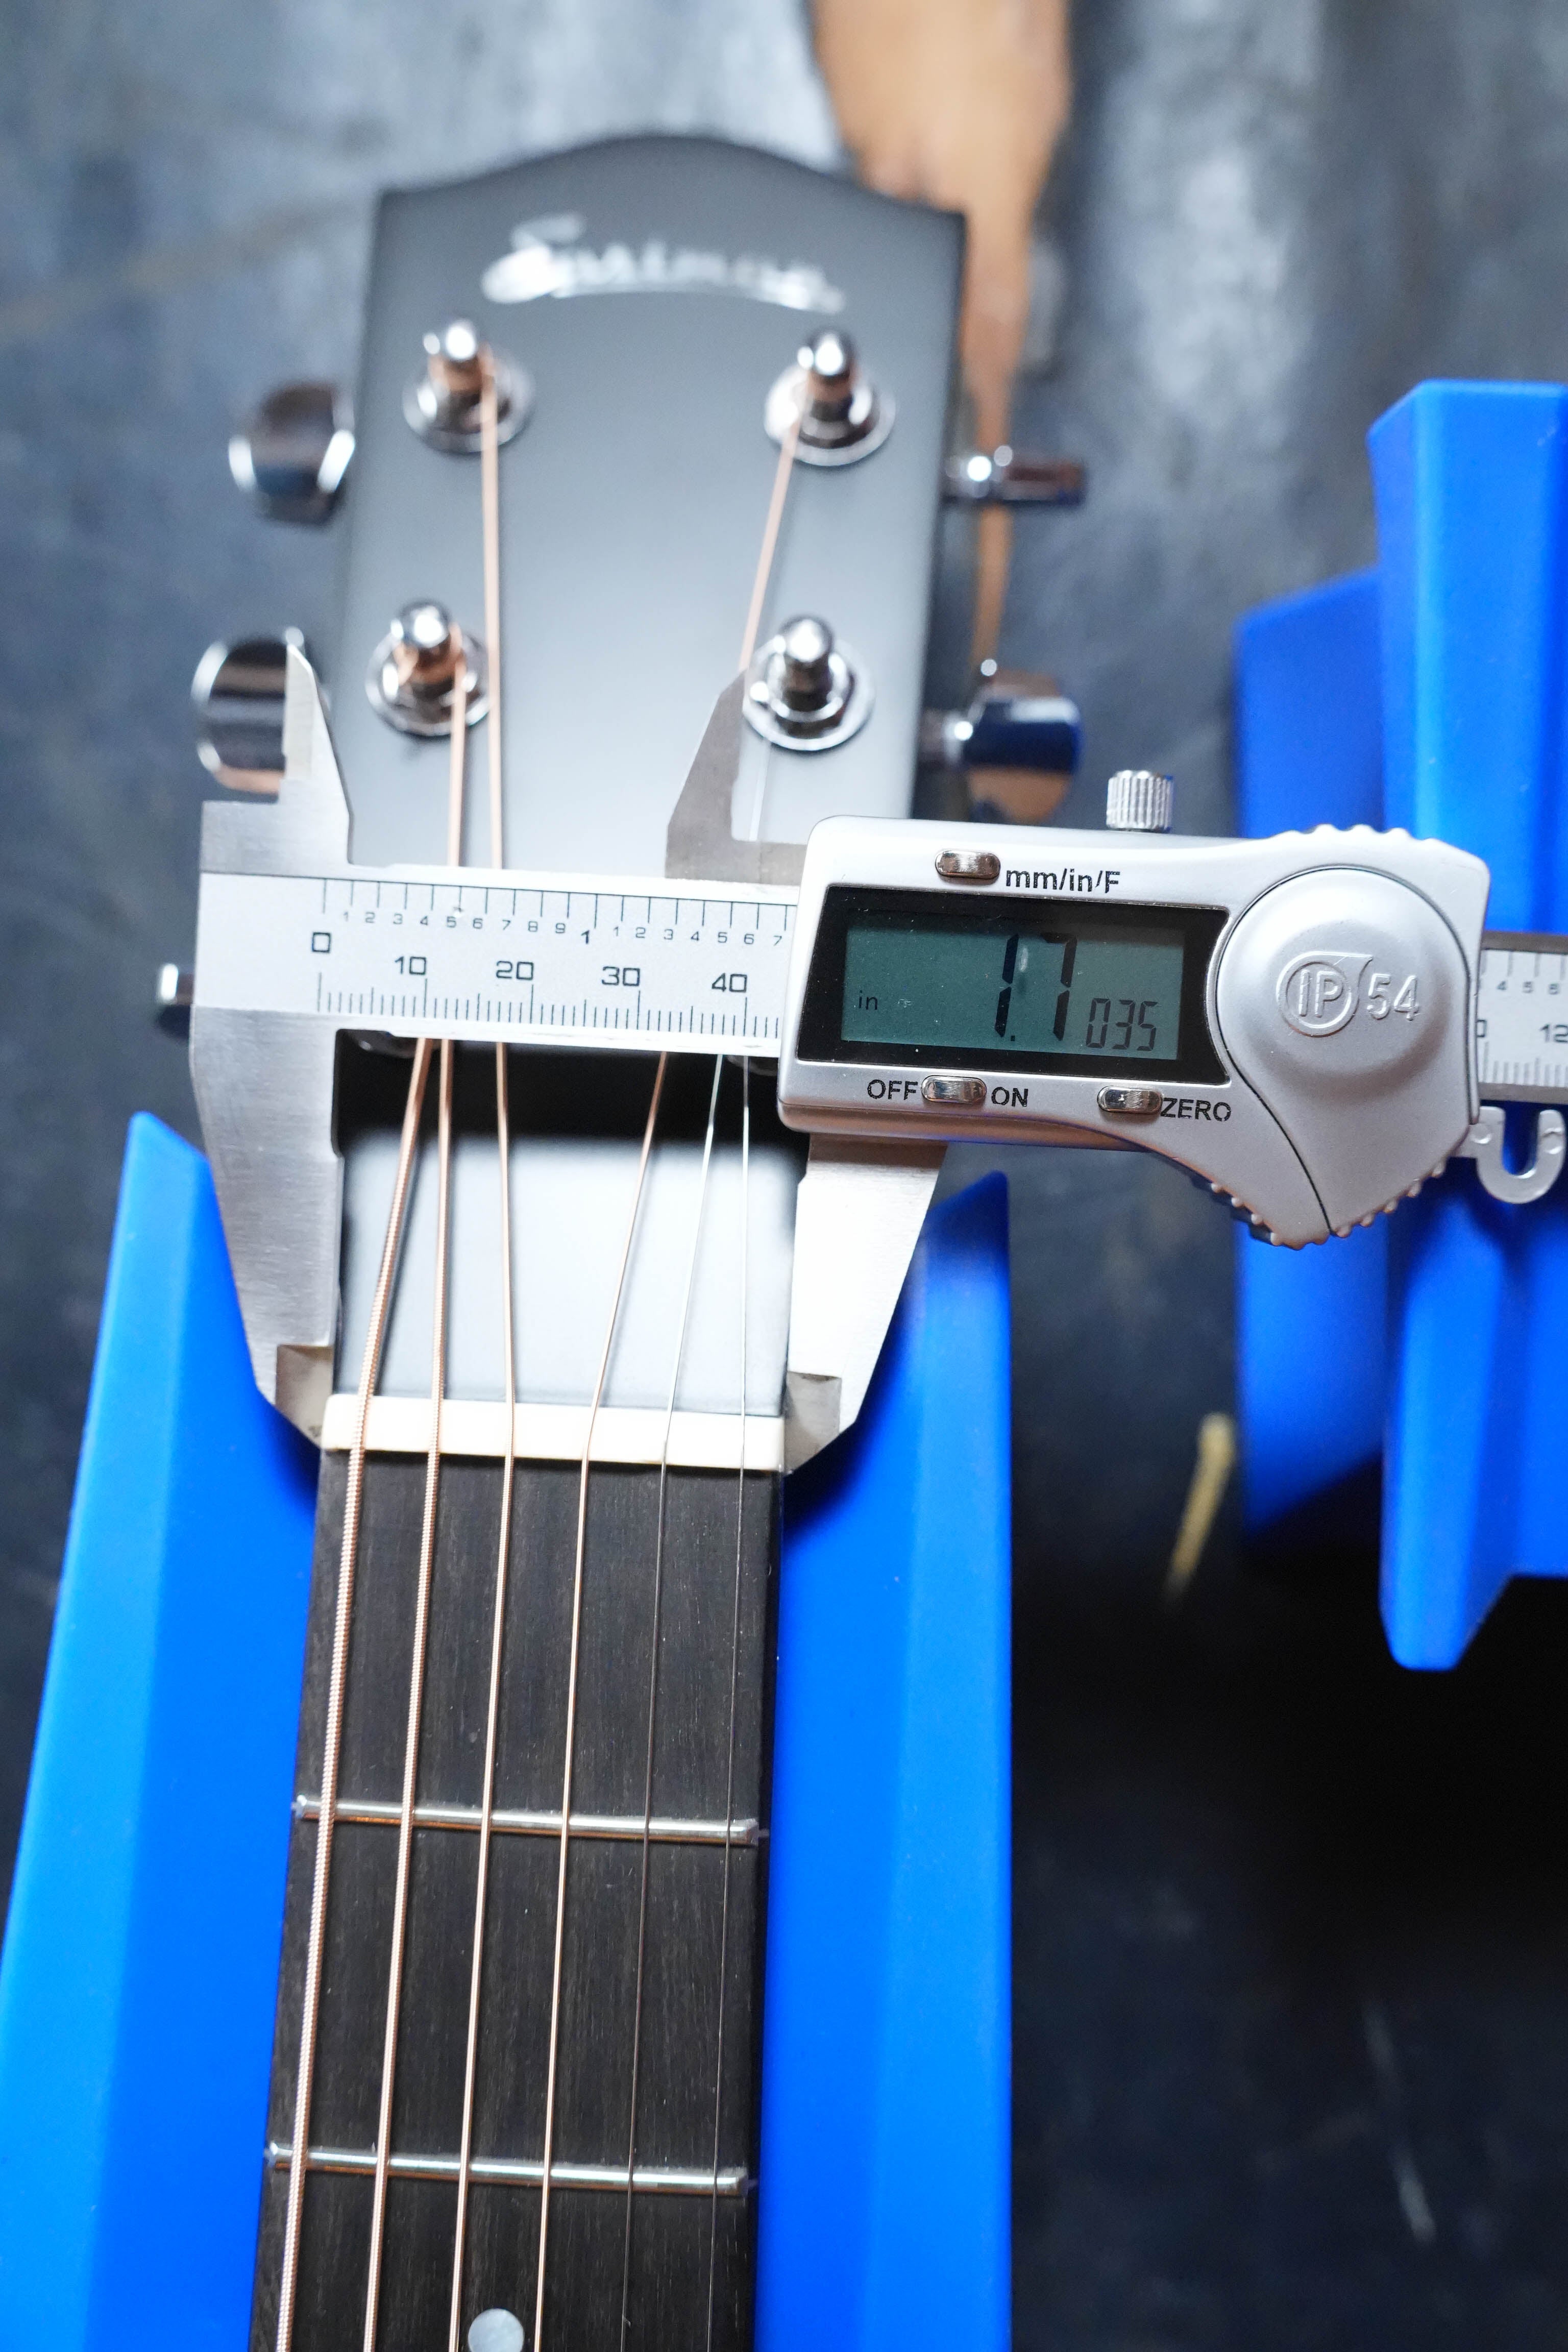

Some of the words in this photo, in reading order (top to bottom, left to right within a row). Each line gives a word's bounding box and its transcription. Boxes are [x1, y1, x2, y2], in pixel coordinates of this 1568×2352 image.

[1006, 868, 1120, 893] mm/in/F
[342, 912, 349, 921] 1
[365, 912, 376, 923] 2
[393, 913, 403, 924] 3
[420, 915, 429, 926] 4
[447, 917, 457, 928] 5
[473, 918, 483, 929] 6
[502, 920, 511, 930] 7
[528, 921, 538, 932] 8
[555, 923, 566, 934] 9
[581, 930, 590, 945] 1
[612, 926, 619, 937] 1
[635, 927, 646, 939] 2
[663, 929, 674, 941] 3
[691, 931, 700, 942] 4
[717, 932, 728, 944] 5
[744, 934, 755, 945] 6
[773, 936, 782, 946] 7
[312, 932, 331, 953] 0
[395, 955, 427, 975] 10
[496, 961, 534, 981] 20
[601, 966, 641, 987] 30
[712, 973, 748, 993] 40
[1298, 970, 1343, 1018] IP
[1366, 973, 1420, 1021] 54
[1497, 981, 1508, 991] 4
[859, 990, 878, 1011] in
[867, 1079, 919, 1100] OFF
[991, 1087, 1028, 1108] ON
[1160, 1097, 1232, 1122] ZERO
